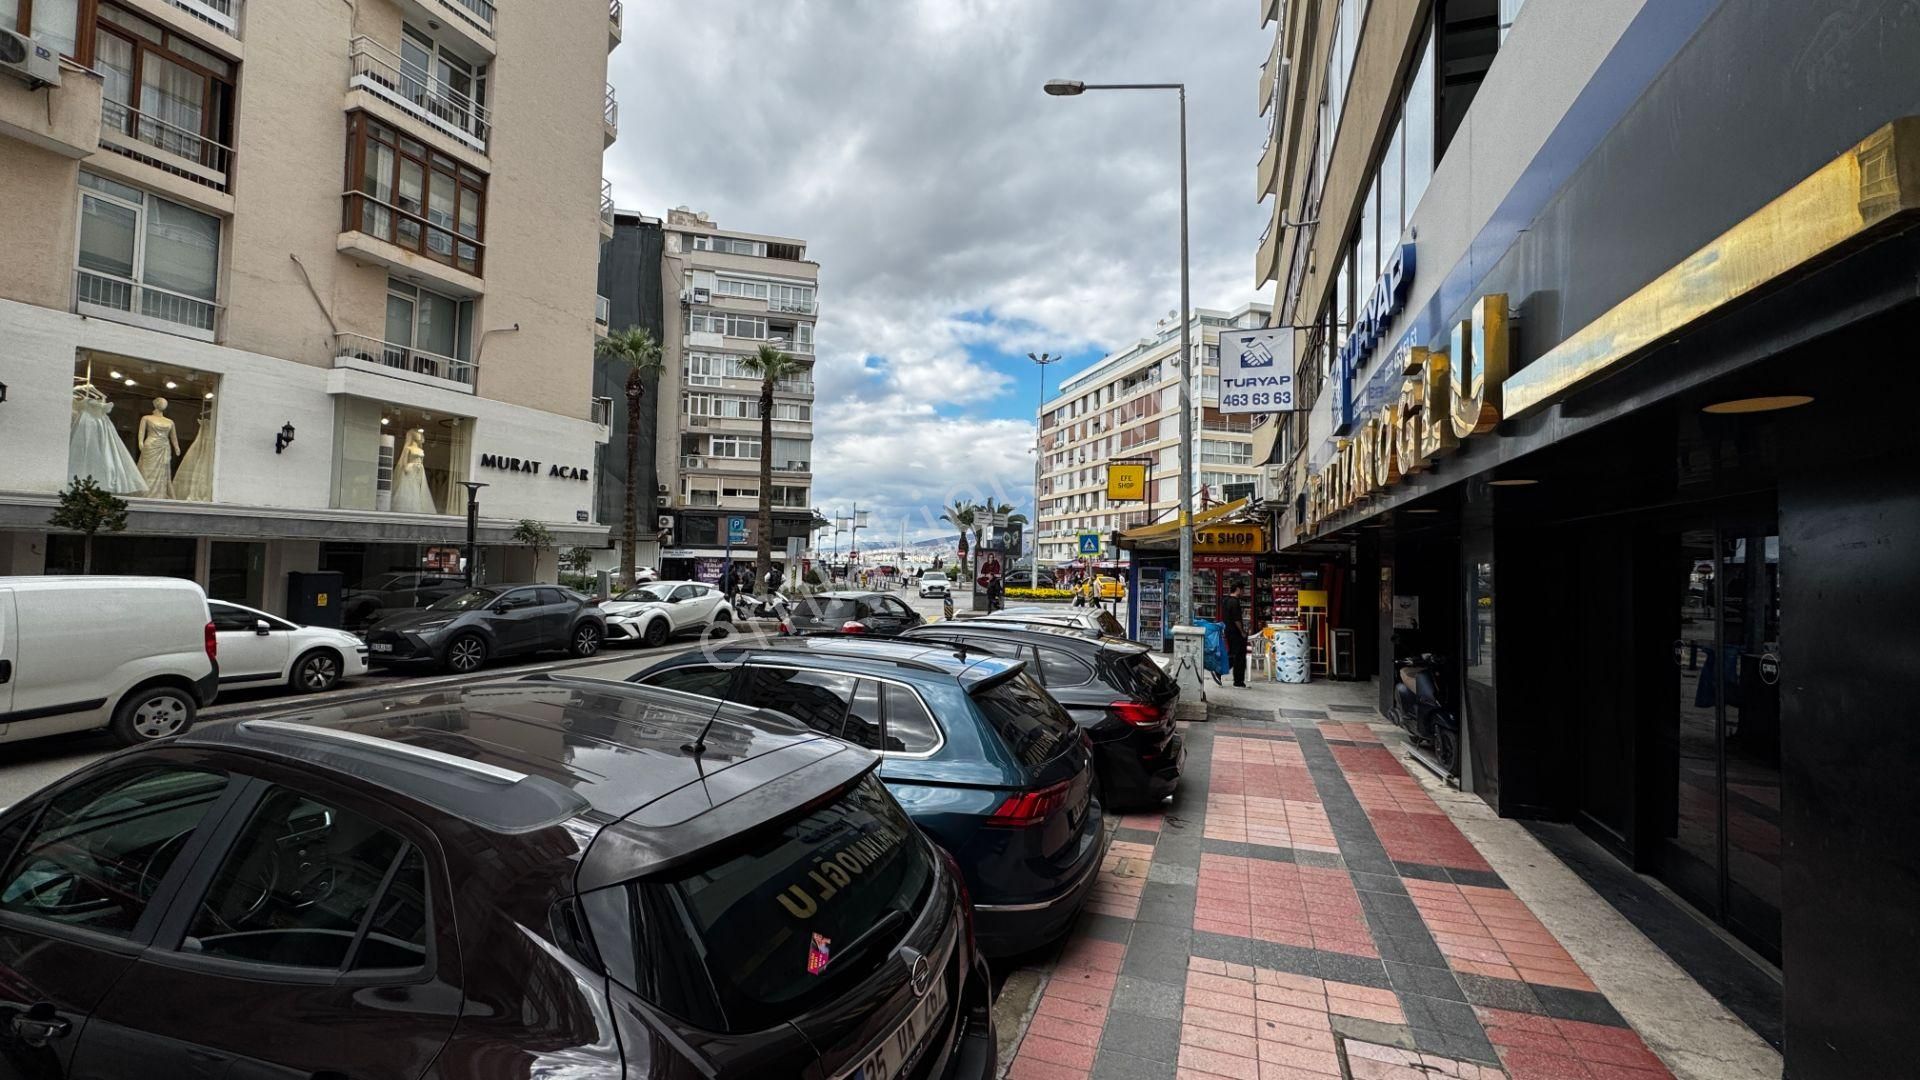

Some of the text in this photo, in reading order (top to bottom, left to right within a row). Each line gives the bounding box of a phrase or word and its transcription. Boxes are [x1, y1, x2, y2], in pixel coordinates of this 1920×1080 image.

[1342, 243, 1417, 378] TURYAP
[1224, 375, 1291, 388] TURYAP
[1223, 391, 1291, 407] 463 63 63
[480, 453, 589, 481] MURAT ACAR
[1218, 532, 1254, 544] SHOP
